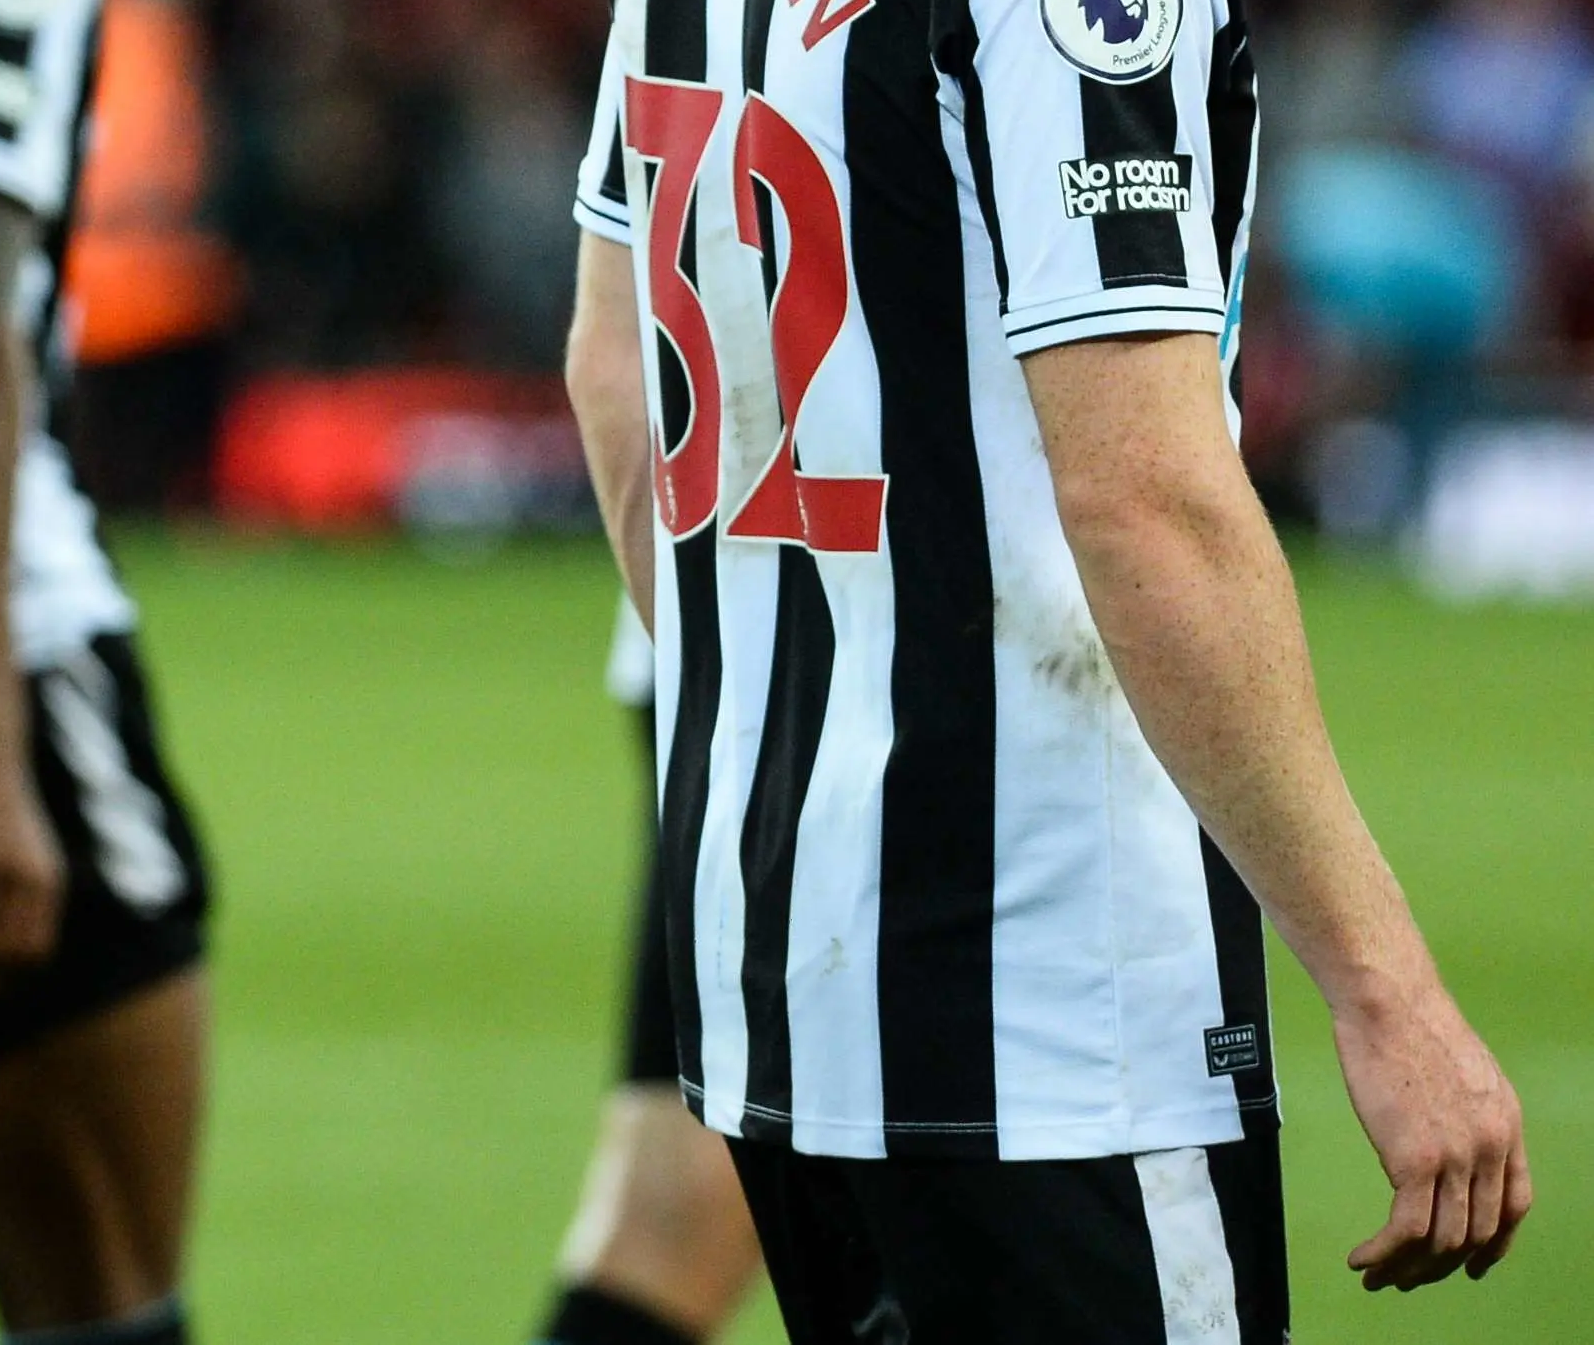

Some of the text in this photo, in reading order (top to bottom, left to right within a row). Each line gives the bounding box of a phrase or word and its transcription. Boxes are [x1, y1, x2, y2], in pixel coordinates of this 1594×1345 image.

[1112, 0, 1168, 66] Premier League
[1060, 159, 1180, 191] No room
[1065, 185, 1190, 218] for racsm
[623, 75, 890, 554] 32
